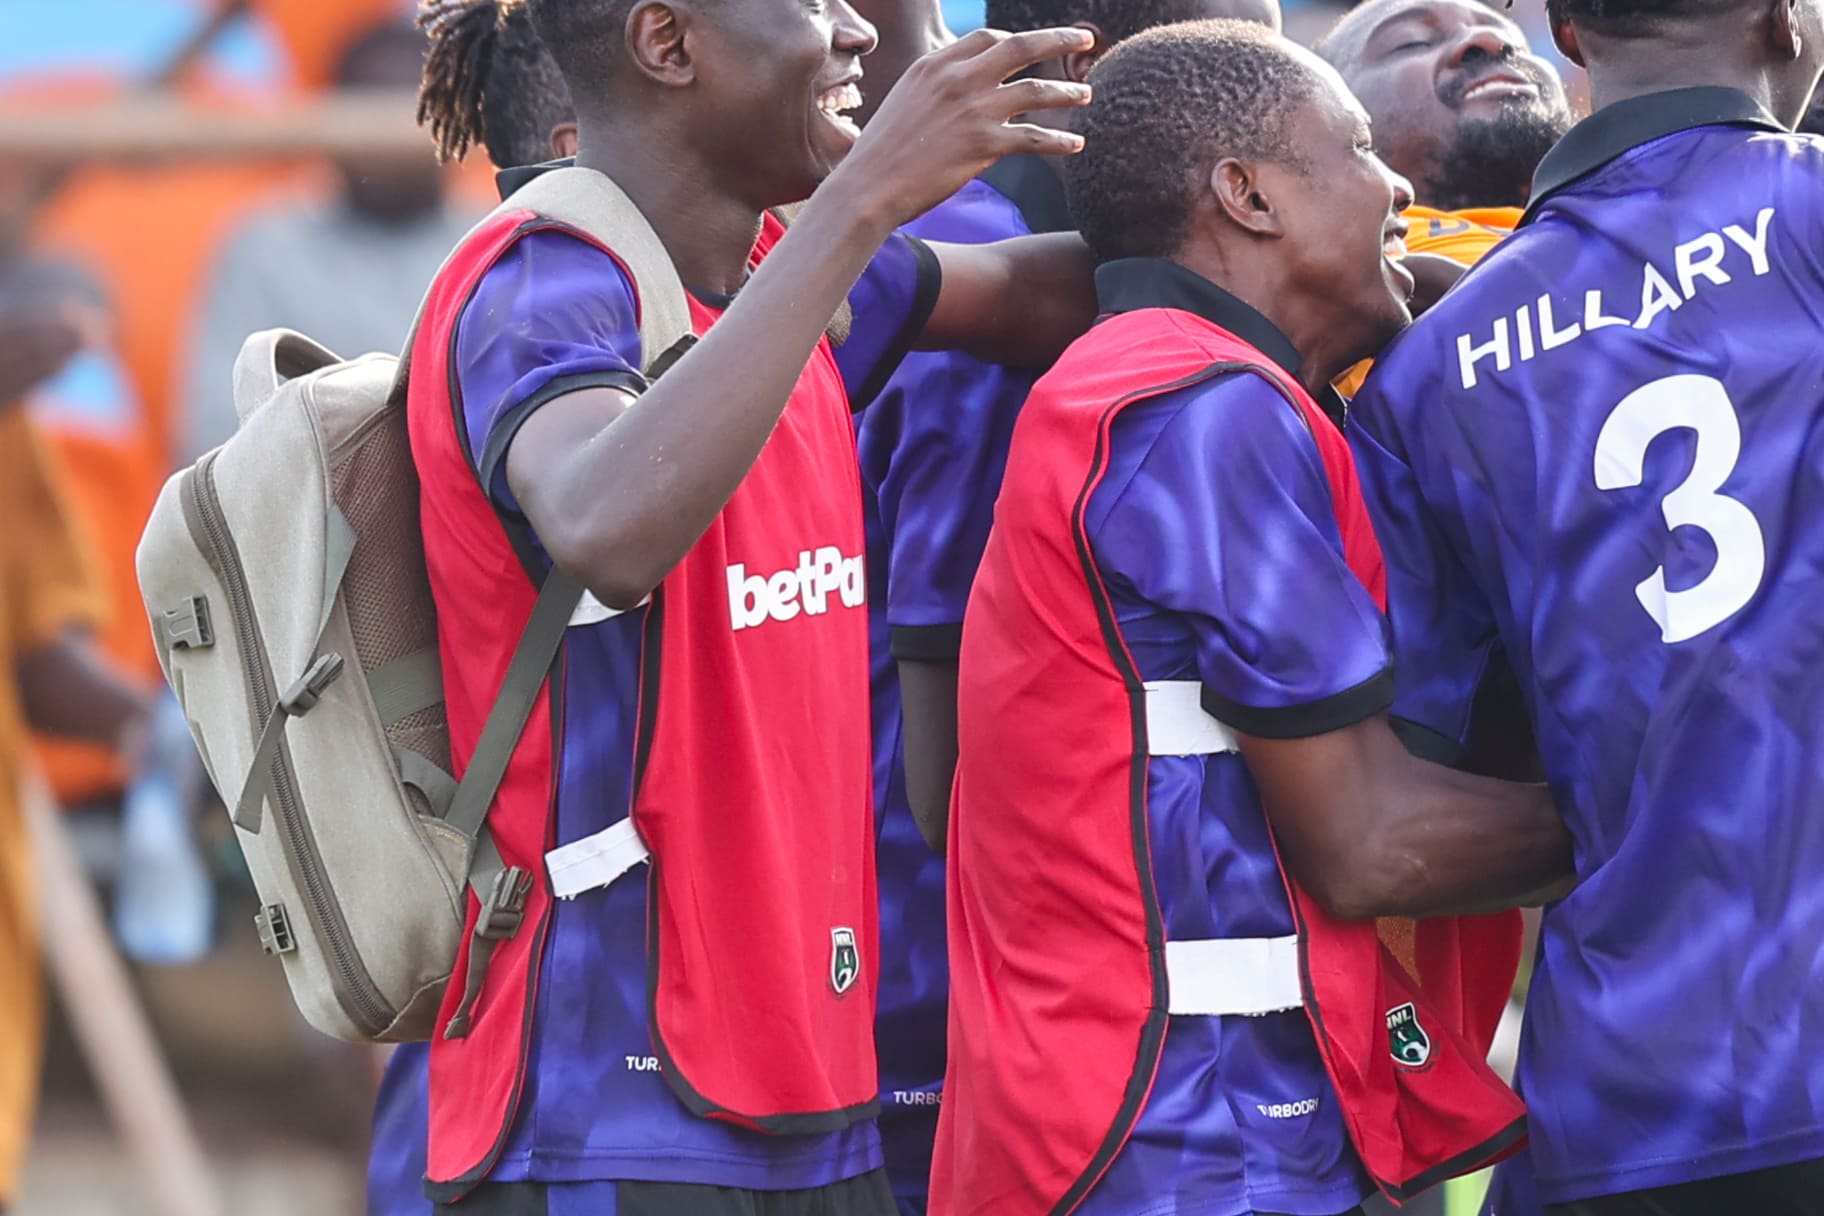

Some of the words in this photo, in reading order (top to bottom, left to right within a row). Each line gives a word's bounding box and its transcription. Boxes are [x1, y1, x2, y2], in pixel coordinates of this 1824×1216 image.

[1456, 207, 1775, 389] HILLARY
[1594, 374, 1765, 642] 3
[726, 546, 864, 630] betPa
[625, 1056, 661, 1071] TUR
